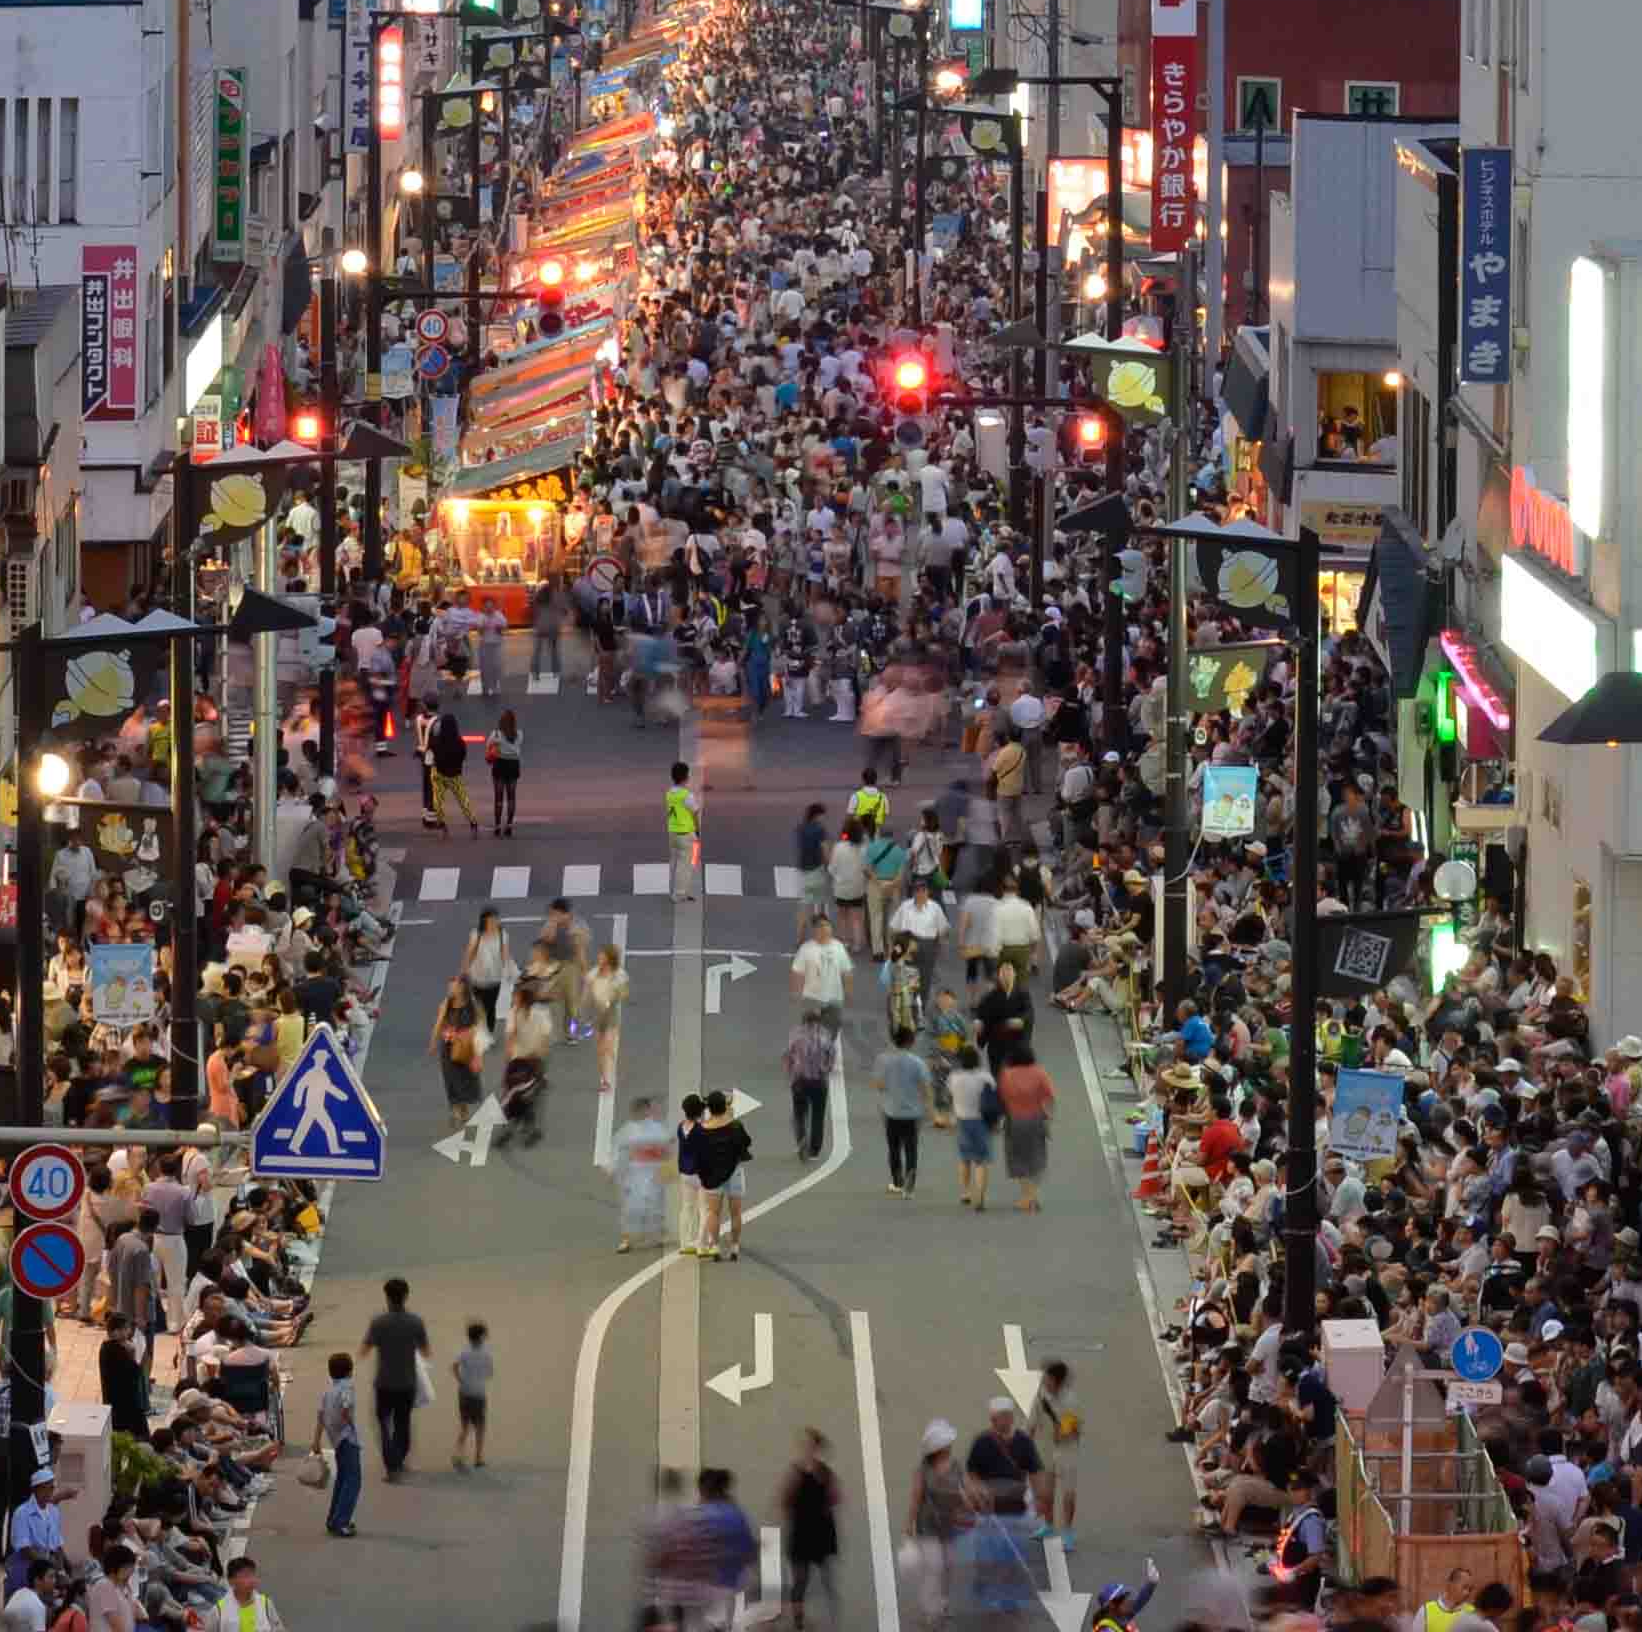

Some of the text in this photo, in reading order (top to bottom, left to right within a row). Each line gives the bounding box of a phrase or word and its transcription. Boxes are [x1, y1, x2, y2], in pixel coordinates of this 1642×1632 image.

[1159, 62, 1187, 228] きらやか銀行
[86, 279, 105, 399] 井出コンタクト
[113, 257, 134, 369] 井出眼科
[423, 319, 442, 334] 40
[1468, 250, 1506, 375] やまき
[27, 1167, 68, 1199] 40
